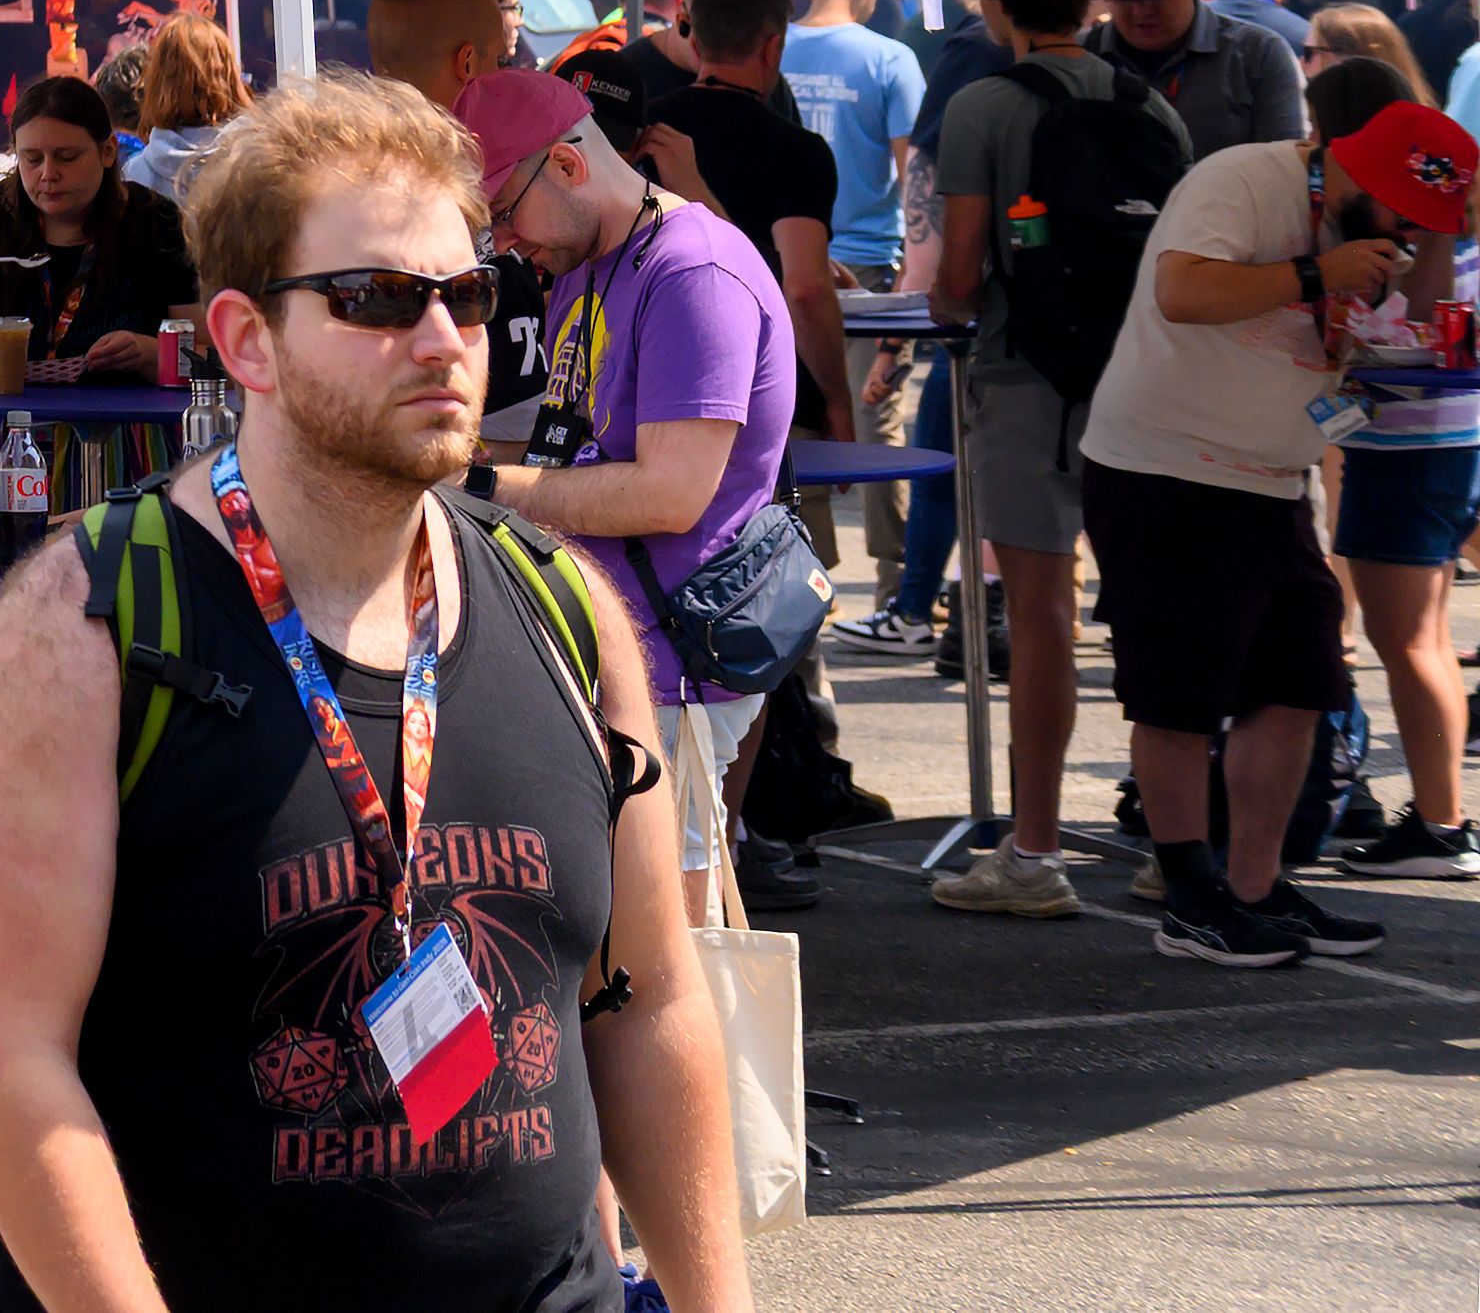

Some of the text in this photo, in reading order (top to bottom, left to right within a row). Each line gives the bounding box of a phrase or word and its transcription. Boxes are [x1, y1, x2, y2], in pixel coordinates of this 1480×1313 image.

[259, 822, 554, 935] DUNEONS
[292, 1063, 316, 1081] 20
[527, 1042, 542, 1057] 20
[272, 1102, 556, 1185] DEADLIFTS
